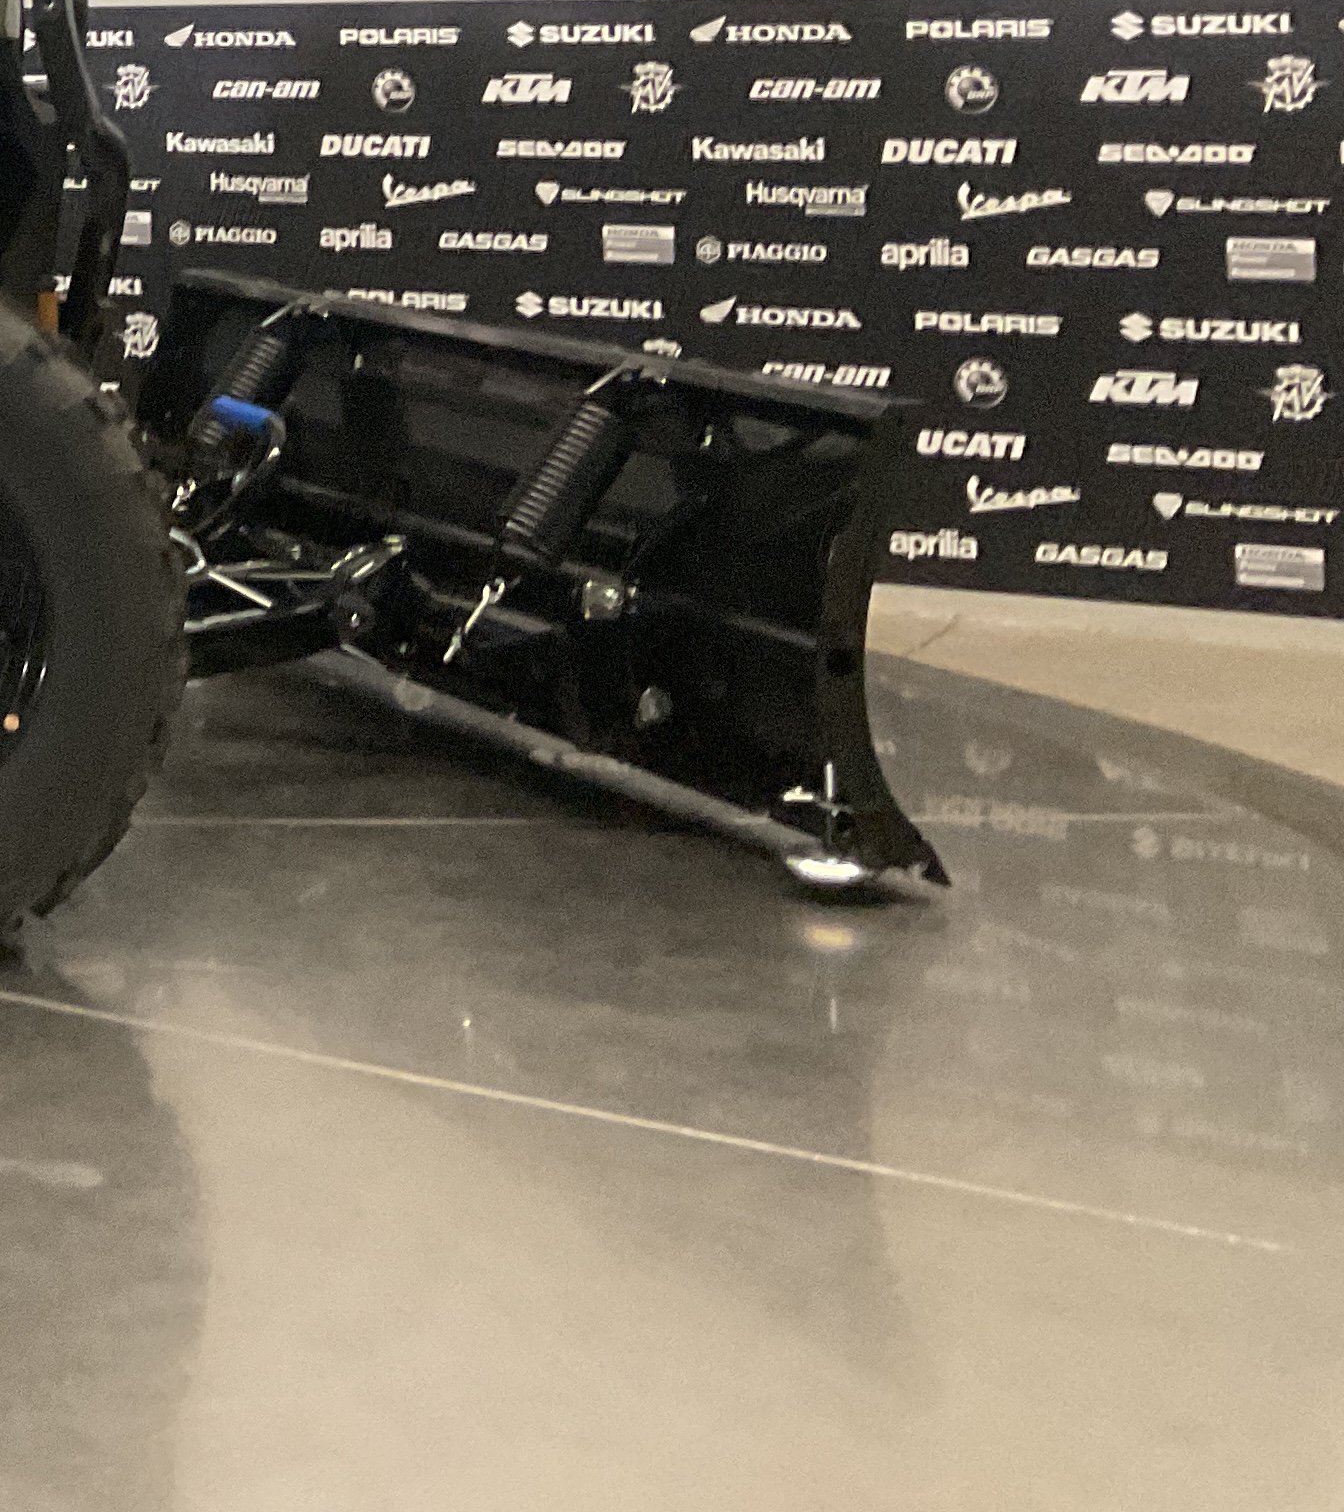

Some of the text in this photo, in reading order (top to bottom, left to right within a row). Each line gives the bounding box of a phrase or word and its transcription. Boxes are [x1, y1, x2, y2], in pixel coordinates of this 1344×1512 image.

[539, 23, 655, 44] SUZUKI
[725, 24, 853, 44] HONDA
[905, 18, 1053, 40] POLARIS
[1150, 12, 1292, 36] SUZUKI
[193, 30, 297, 48] HONDA
[339, 27, 461, 46] POLARIS
[212, 80, 321, 99] can-am
[481, 73, 572, 103] KTM
[749, 78, 882, 100] can-am
[1079, 69, 1190, 103] KTM
[165, 131, 275, 154] Kawasaki
[319, 134, 431, 158] DUCATI
[691, 136, 825, 161] Kawasaki
[881, 138, 1017, 165] DUCATI
[210, 172, 310, 196] Husqvarna
[382, 173, 476, 208] Vespa
[746, 182, 869, 207] Husqvarna
[957, 181, 1072, 221] Vespa
[194, 226, 277, 244] PIAGGIO
[319, 222, 393, 253] aprilia
[438, 231, 548, 252] GASGAS
[727, 242, 828, 262] PIAGGIO
[880, 237, 969, 271] aprilia
[1026, 246, 1160, 269] GASGAS
[548, 296, 664, 320] SUZUKI
[736, 306, 862, 329] HONDA
[914, 310, 1062, 336] POLARIS
[1159, 317, 1300, 344] SUZUKI
[1088, 369, 1199, 406] KTM
[916, 429, 1026, 460] UCATI
[966, 474, 1081, 513] Vespa
[889, 528, 978, 561] aprilia
[1034, 543, 1168, 571] GASGAS
